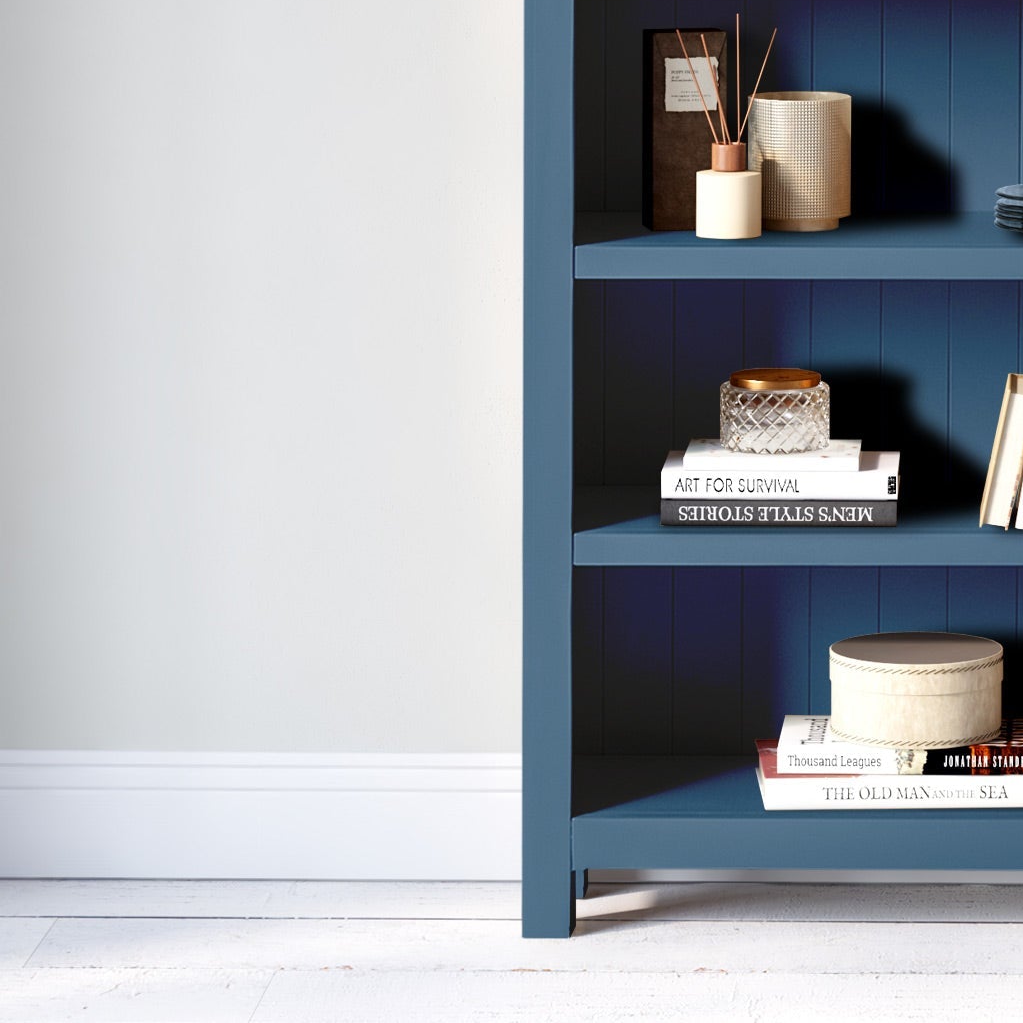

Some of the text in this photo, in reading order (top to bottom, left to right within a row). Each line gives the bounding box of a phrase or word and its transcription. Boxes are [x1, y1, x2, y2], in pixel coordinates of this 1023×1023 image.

[675, 478, 800, 493] ART FOR SURVIVAL
[678, 506, 874, 522] MEN'S STYLE STORIES
[788, 754, 882, 770] Thousand Leagues
[943, 755, 988, 768] JONATHAN
[823, 785, 1009, 801] THE OLD MAN AND THE SEA
